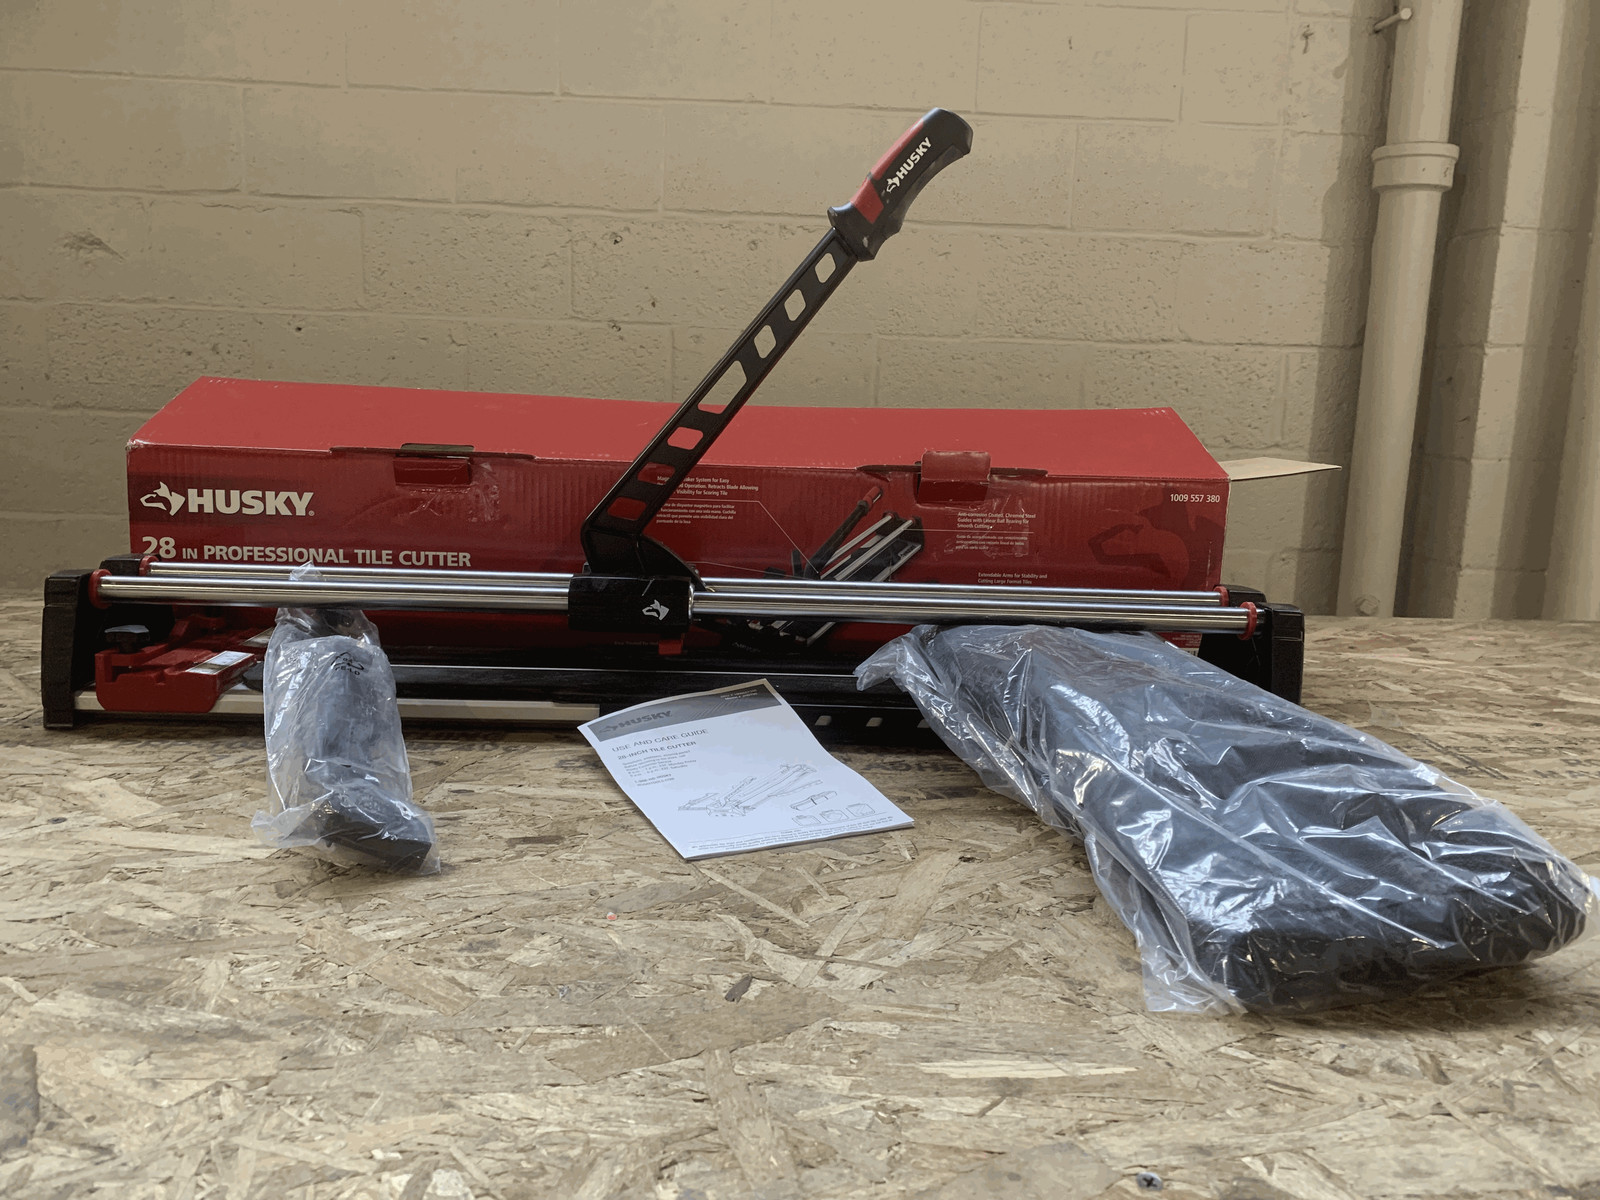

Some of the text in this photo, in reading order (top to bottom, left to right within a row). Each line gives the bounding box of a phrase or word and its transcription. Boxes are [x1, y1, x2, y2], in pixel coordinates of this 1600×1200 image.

[895, 136, 931, 179] HUSKY
[1170, 493, 1221, 503] 1009 557 380
[142, 536, 471, 567] 28 IN PROFESSIONAL TILE CUTTER
[618, 710, 672, 728] HUSKY
[612, 728, 709, 753] USE AND CARE GUIDE
[617, 748, 649, 760] 28-INCH
[666, 740, 697, 750] CUTTER
